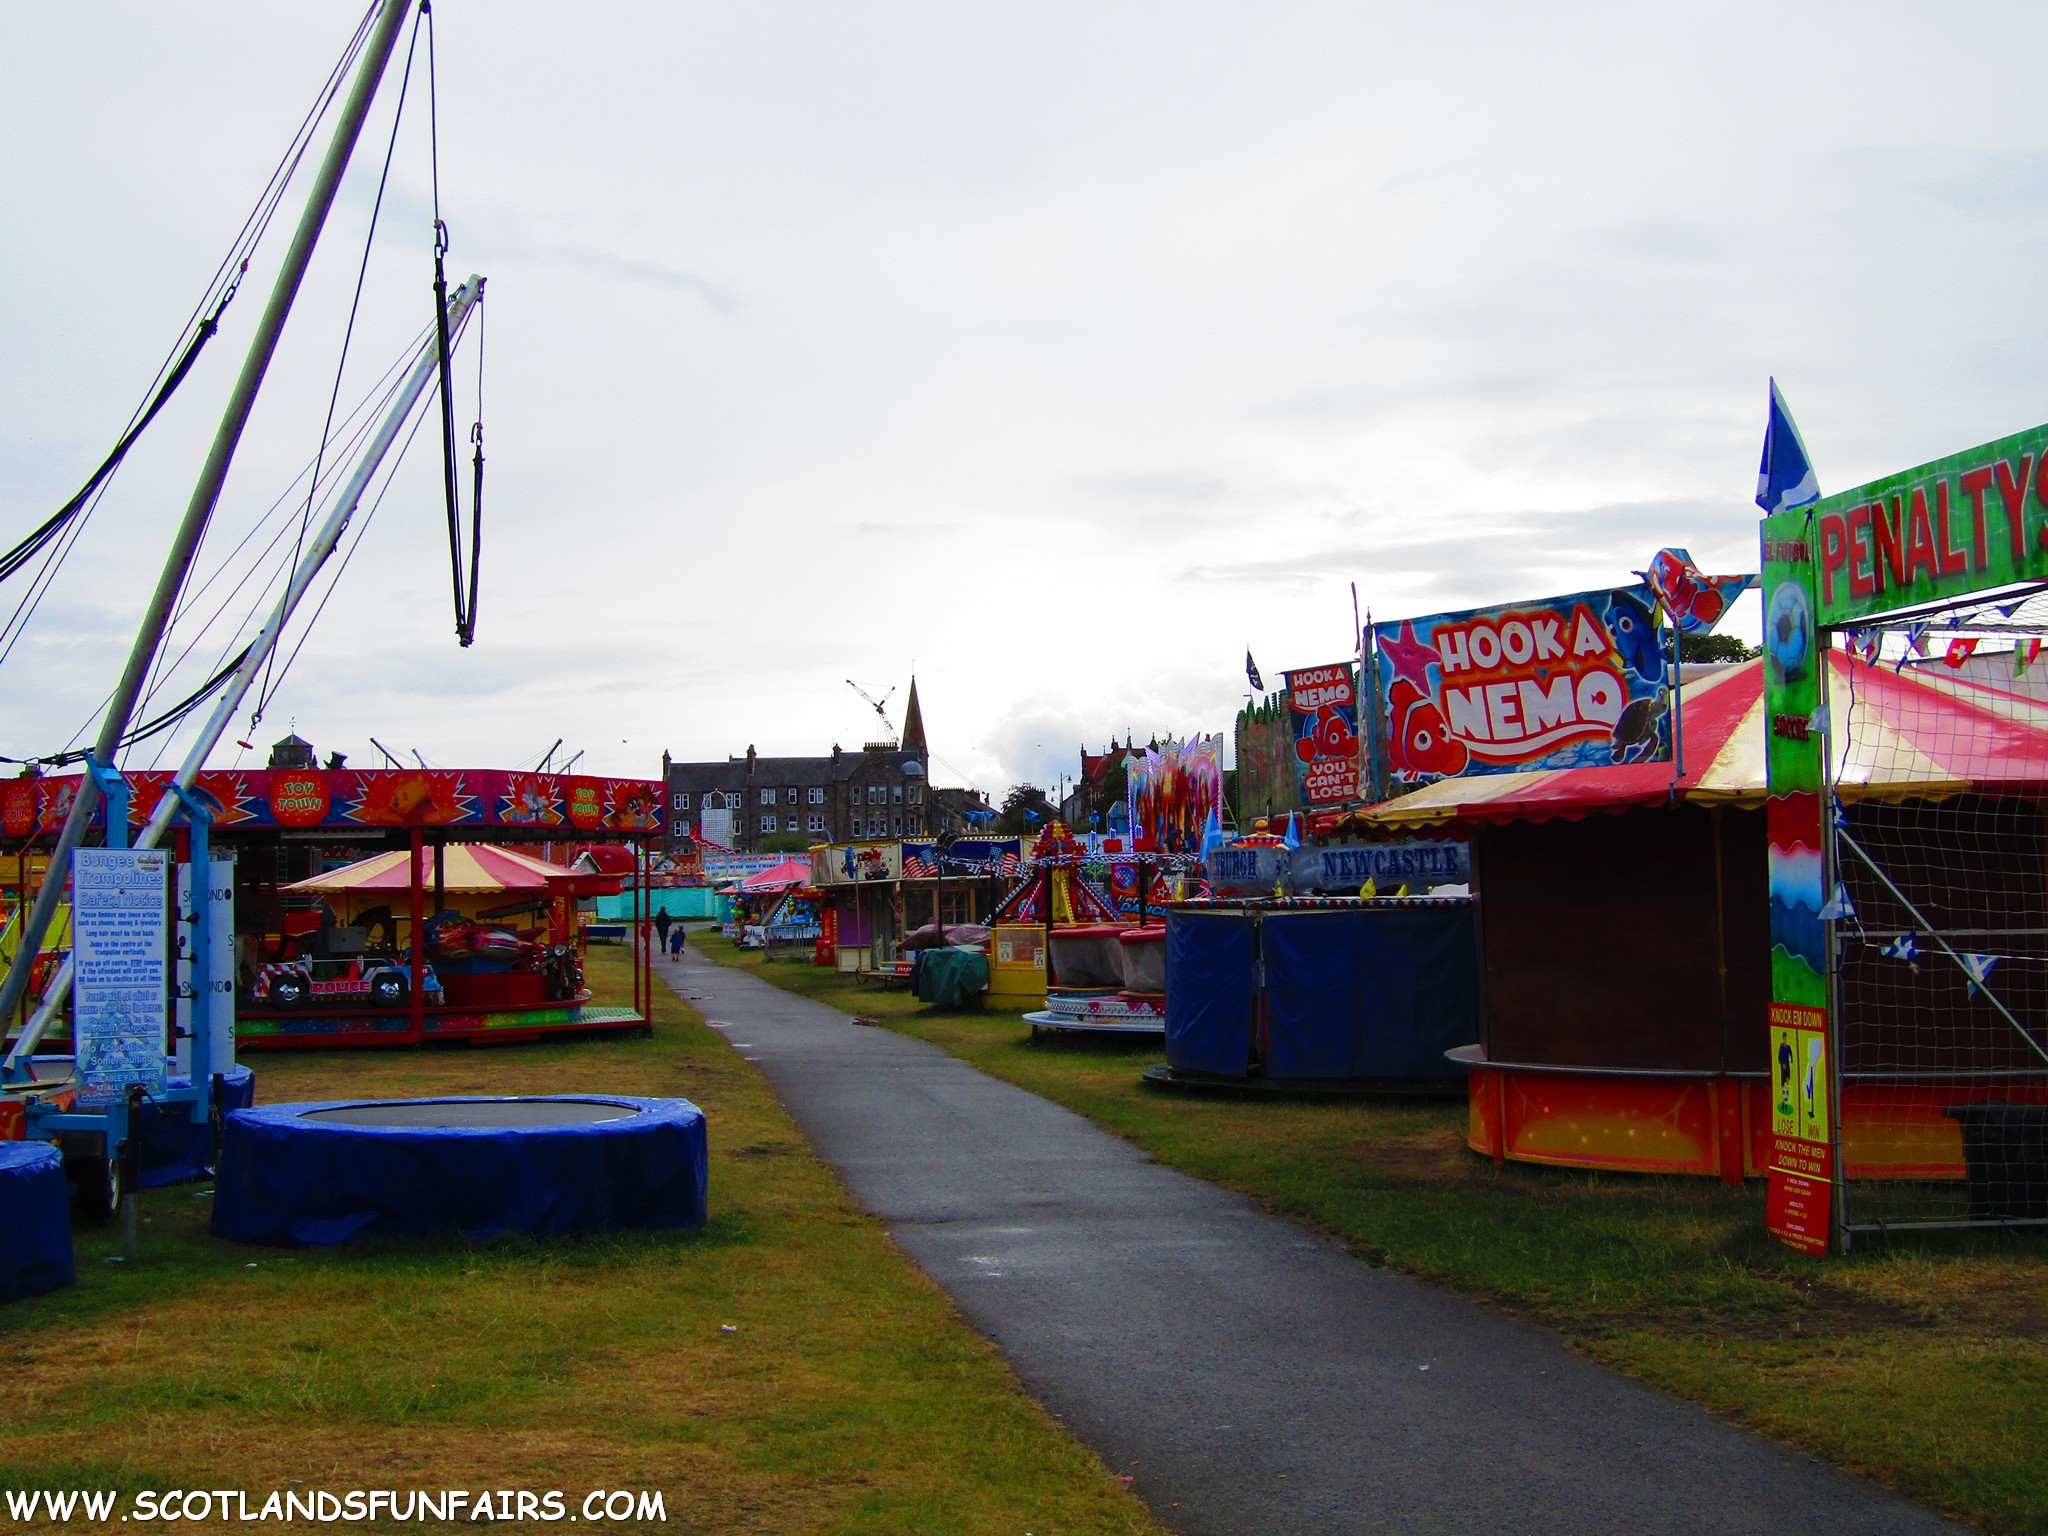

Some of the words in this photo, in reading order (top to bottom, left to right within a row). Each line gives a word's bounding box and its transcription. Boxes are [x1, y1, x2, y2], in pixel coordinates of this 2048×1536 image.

[1820, 448, 2048, 608] PENALTY
[1437, 616, 1566, 674] HOOK
[1572, 612, 1606, 658] A
[1292, 668, 1334, 688] HOOK
[1335, 668, 1346, 681] A
[1294, 683, 1351, 707] NEMO
[1445, 670, 1623, 741] NEMO
[1311, 761, 1347, 775] YOU
[1305, 771, 1356, 788] CAN'T
[283, 782, 314, 797] TOY
[575, 788, 596, 802] TOY
[1310, 784, 1355, 800] LOSE
[278, 798, 323, 812] TOWN
[572, 803, 600, 817] TOWN
[82, 852, 135, 869] Bungee
[1321, 847, 1458, 880] NEWCASTLE
[79, 870, 163, 887] Trampolines
[79, 891, 120, 908] Safety
[125, 892, 163, 907] Notice
[312, 980, 370, 994] POLICE
[1771, 1007, 1792, 1025] KNOCK
[1793, 1010, 1803, 1027] EM
[1803, 1011, 1823, 1029] DOWN
[99, 1042, 147, 1053] Acrobatics
[150, 1042, 160, 1051] or
[91, 1056, 154, 1066] Somersaulting
[125, 1073, 140, 1082] FOR
[141, 1072, 158, 1081] HIRE
[1777, 1118, 1794, 1135] LOSE
[1807, 1123, 1820, 1141] WIN
[1775, 1138, 1797, 1154] KNOCK
[1798, 1143, 1810, 1157] THE
[1810, 1145, 1826, 1160] MEN
[1778, 1154, 1798, 1169] DOWN
[1799, 1158, 1808, 1171] TO
[1808, 1160, 1822, 1174] WIN
[1789, 1200, 1804, 1209] ADULTS
[1785, 1222, 1805, 1233] CHILDREN
